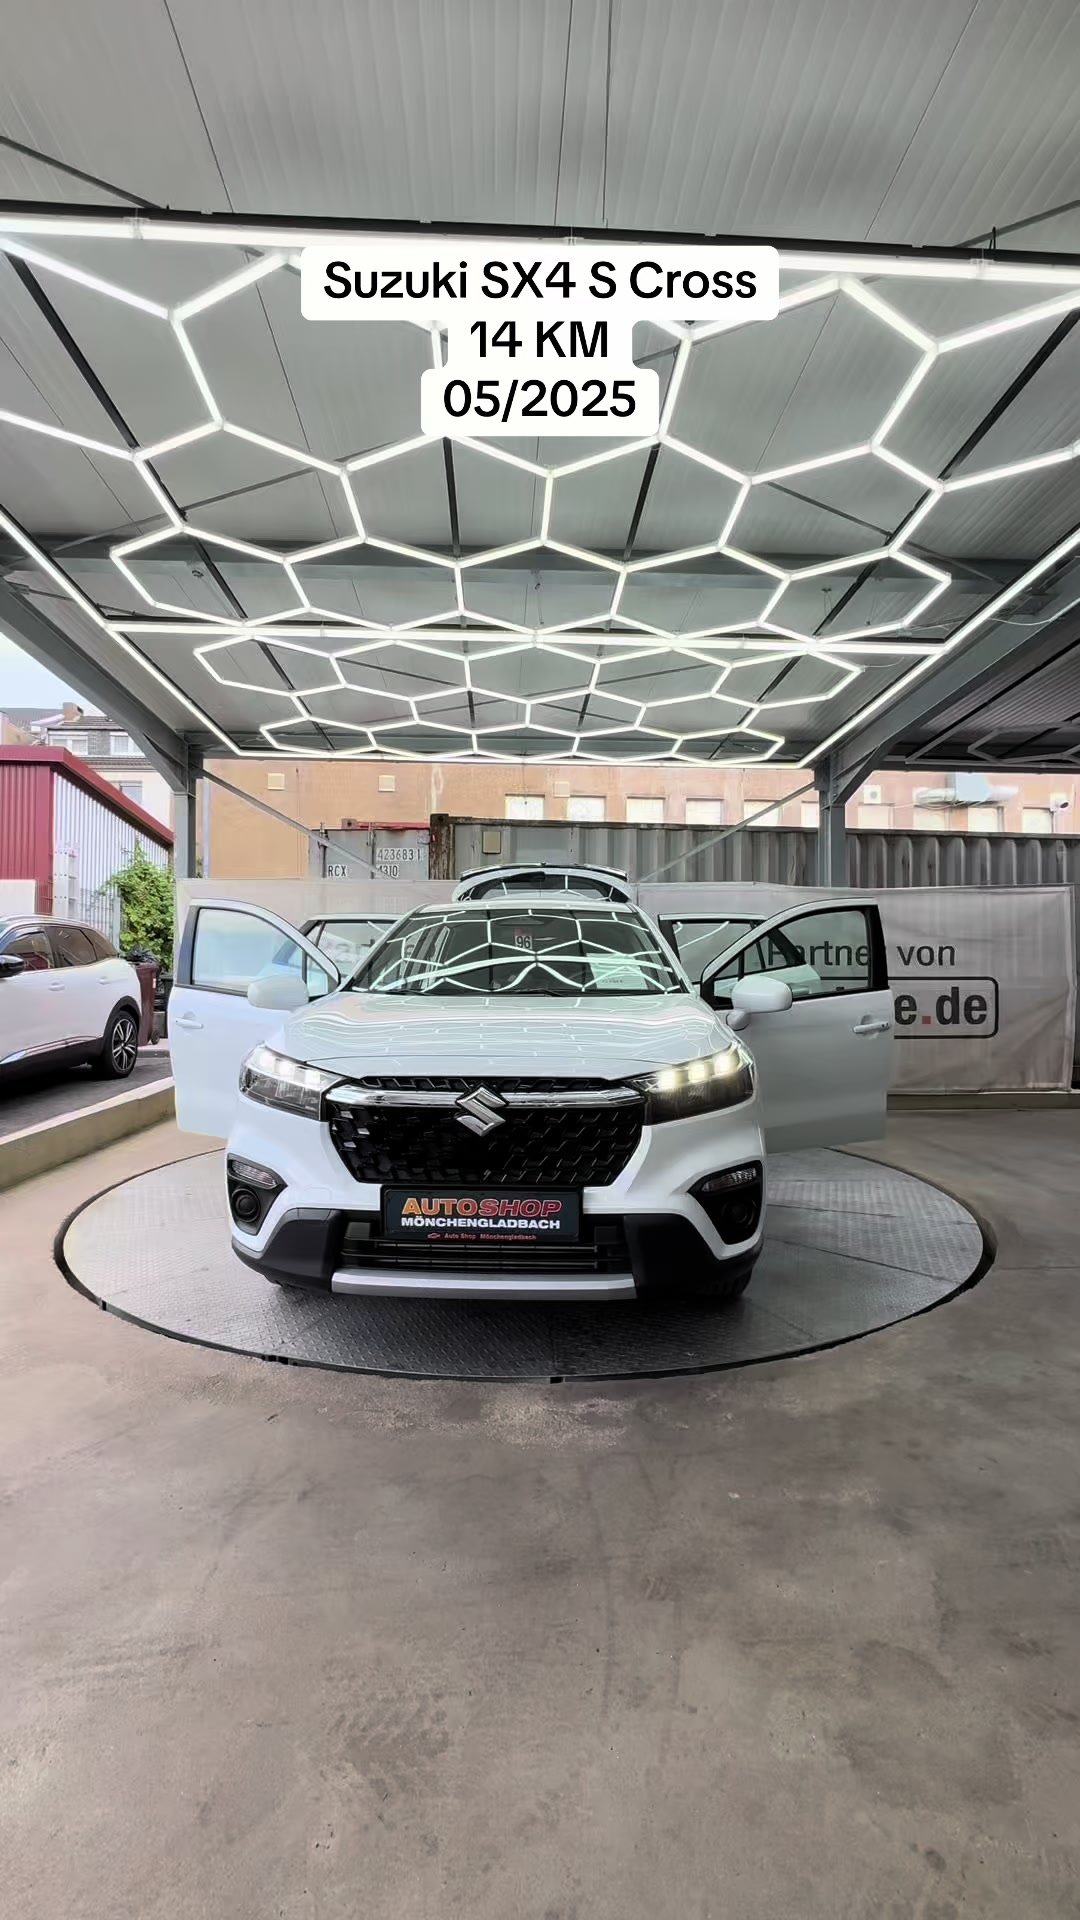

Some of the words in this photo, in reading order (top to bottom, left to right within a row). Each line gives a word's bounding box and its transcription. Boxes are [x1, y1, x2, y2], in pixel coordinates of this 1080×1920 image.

[328, 865, 347, 877] RCX
[516, 935, 531, 949] 96
[767, 940, 886, 967] Prtne
[897, 945, 956, 967] von
[894, 986, 987, 1026] e.de
[401, 1197, 563, 1218] AUTOSHOP
[401, 1215, 561, 1230] MÖNCHENGLADBACH
